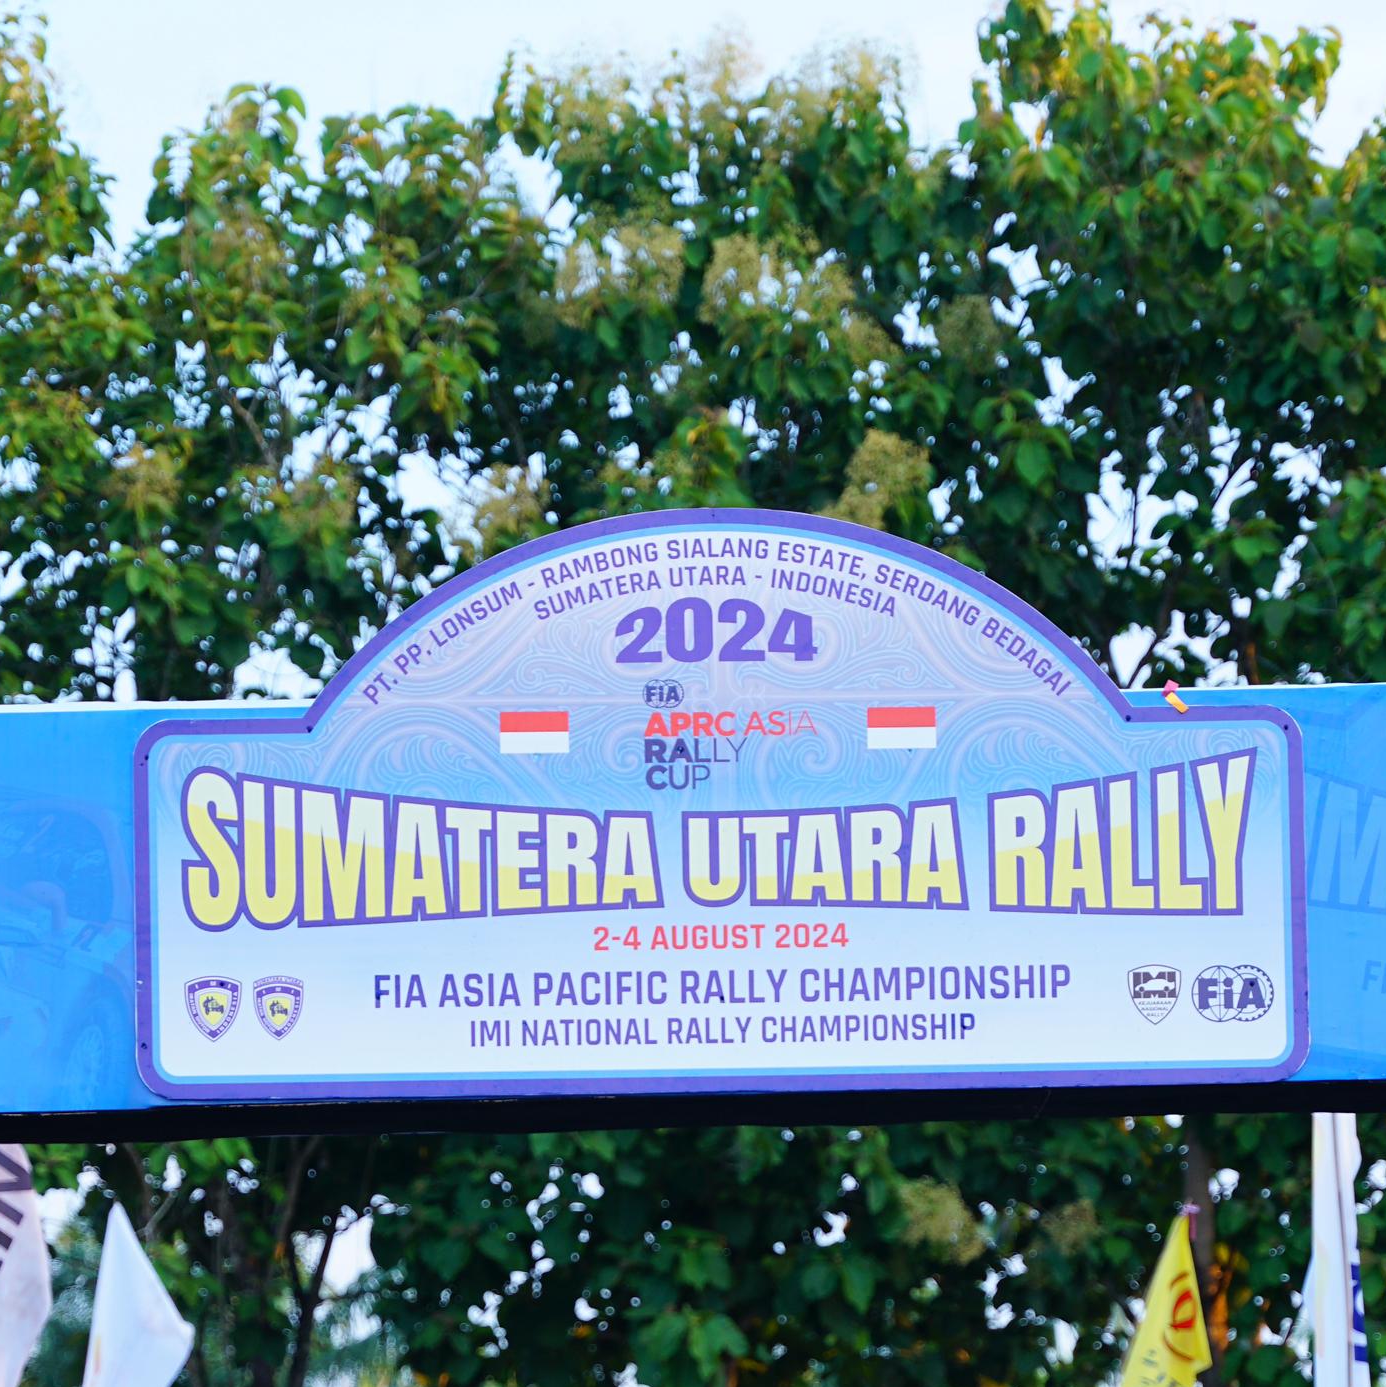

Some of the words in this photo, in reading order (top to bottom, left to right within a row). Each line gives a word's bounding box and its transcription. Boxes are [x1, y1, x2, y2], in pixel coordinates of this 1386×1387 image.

[533, 569, 663, 621] SUMATERA
[669, 565, 747, 587] UTARA
[769, 568, 897, 618] INDONESIA
[363, 673, 399, 705] PT.
[394, 642, 432, 676] PP.
[429, 581, 523, 648] LONSUM
[540, 542, 659, 589] RAMBONG
[666, 537, 769, 562] SIALANG
[777, 541, 867, 580] ESTATE,
[874, 563, 981, 627] SERDANG
[980, 616, 1072, 697] BEDAGAI
[615, 597, 818, 663] 2024
[644, 711, 736, 737] APRC
[743, 710, 819, 736] ASIA
[644, 737, 748, 764] RALLY
[645, 764, 711, 791] CUP
[181, 765, 664, 932] SUMATERA
[682, 797, 970, 911] UTARA
[988, 747, 1258, 916] RALLY
[592, 925, 642, 952] 2-4
[650, 924, 765, 951] AUGUST
[774, 922, 850, 949] 2024
[373, 974, 428, 1009] FIA
[438, 973, 522, 1008] ASIA
[532, 971, 668, 1007] PACIFIC
[680, 968, 788, 1004] RALLY
[798, 963, 1072, 1002] CHAMPIONSHIP
[470, 1019, 512, 1048] IMI
[521, 1017, 659, 1048] NATIONAL
[666, 1015, 752, 1045] RALLY
[761, 1013, 977, 1043] CHAMPIONSHIP
